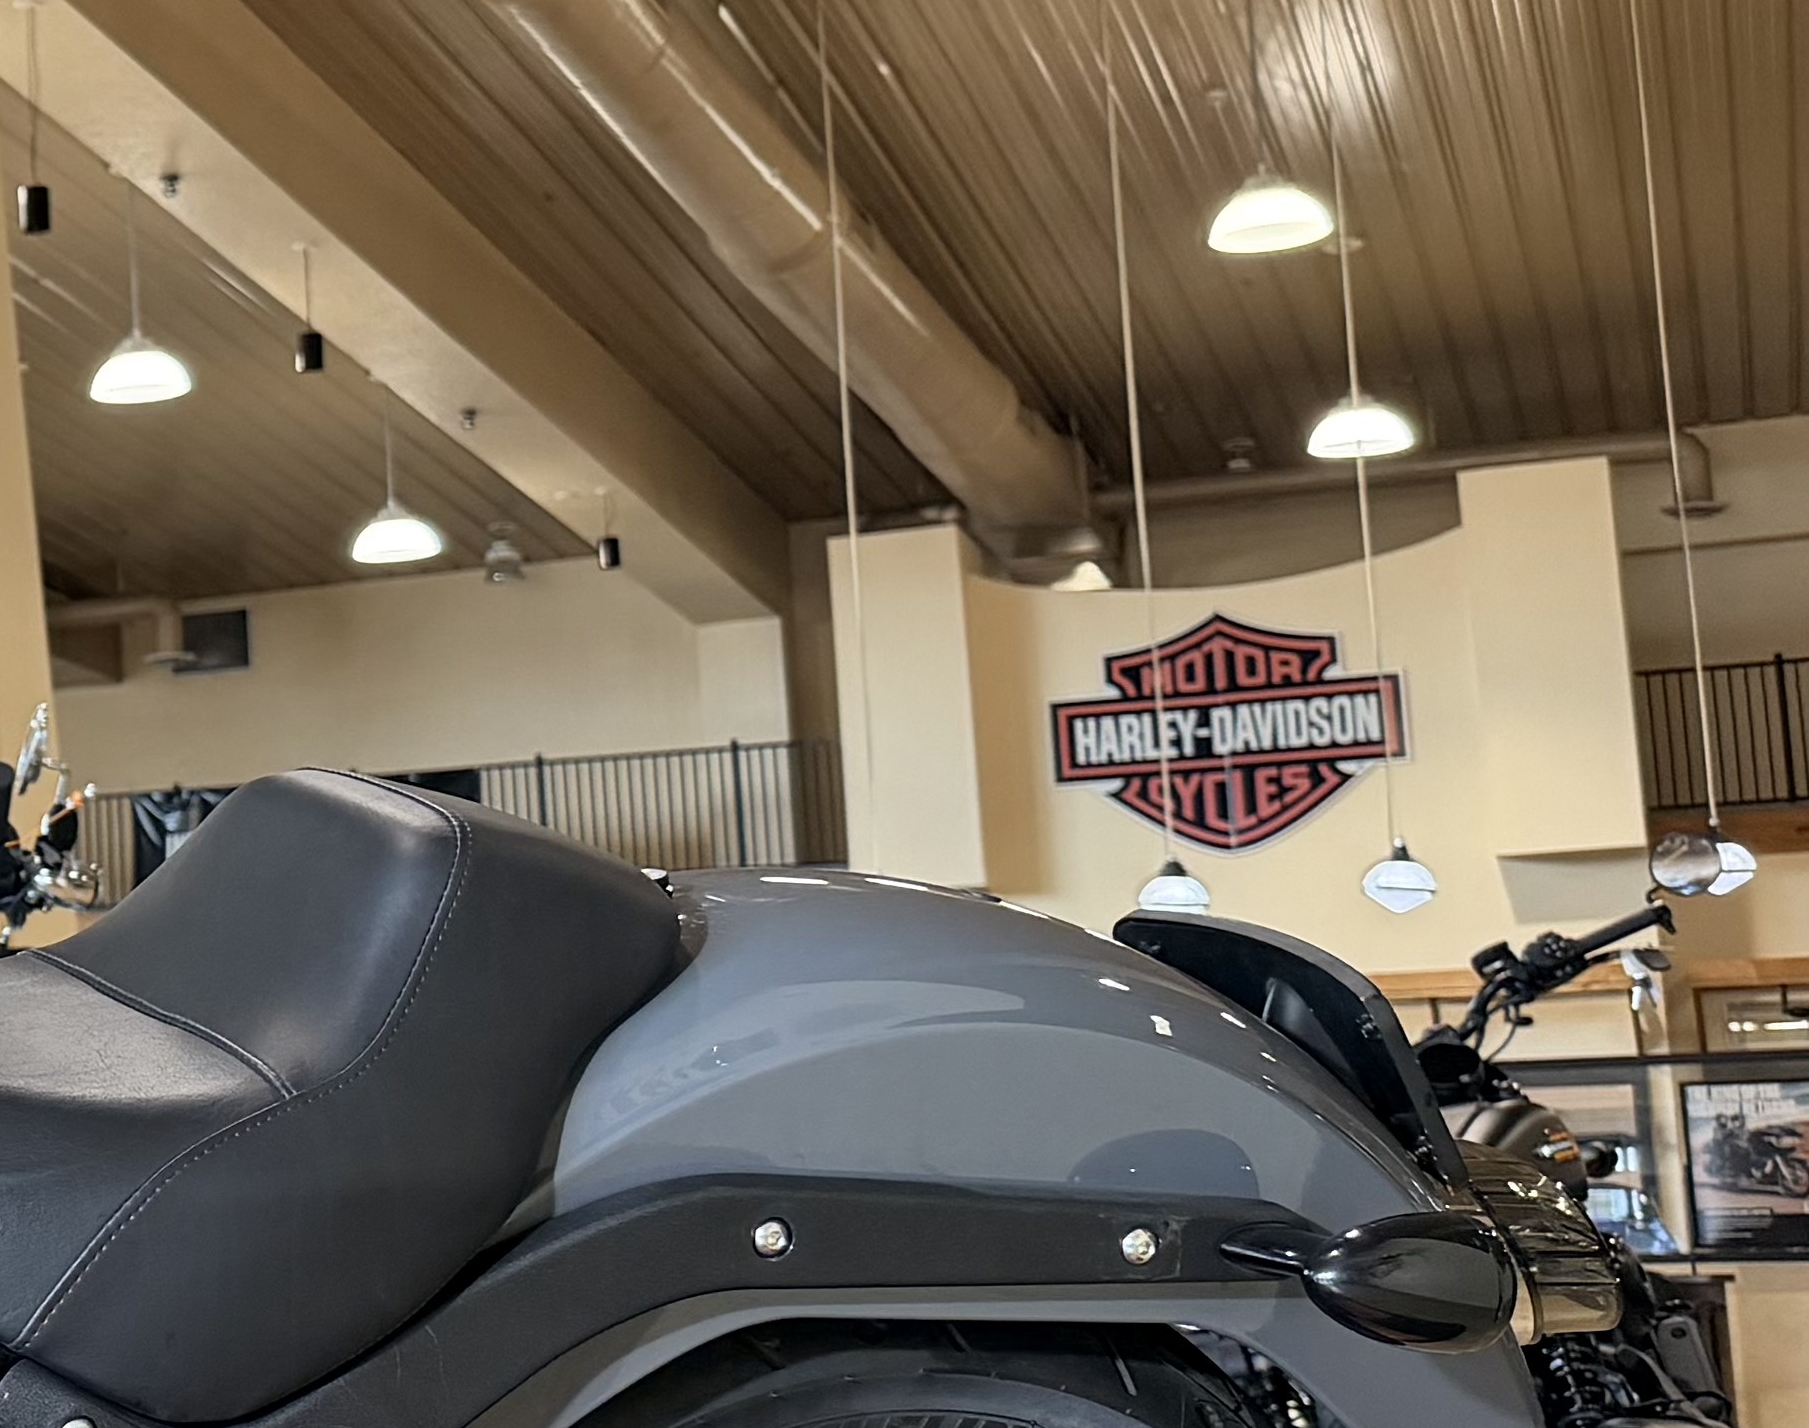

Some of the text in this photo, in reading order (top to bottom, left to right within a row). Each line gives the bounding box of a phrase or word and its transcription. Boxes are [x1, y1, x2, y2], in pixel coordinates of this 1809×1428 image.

[1140, 637, 1304, 696] MOTOR
[1072, 692, 1382, 766] HARLEY-DAVIDSON
[1147, 762, 1312, 833] CYCLES
